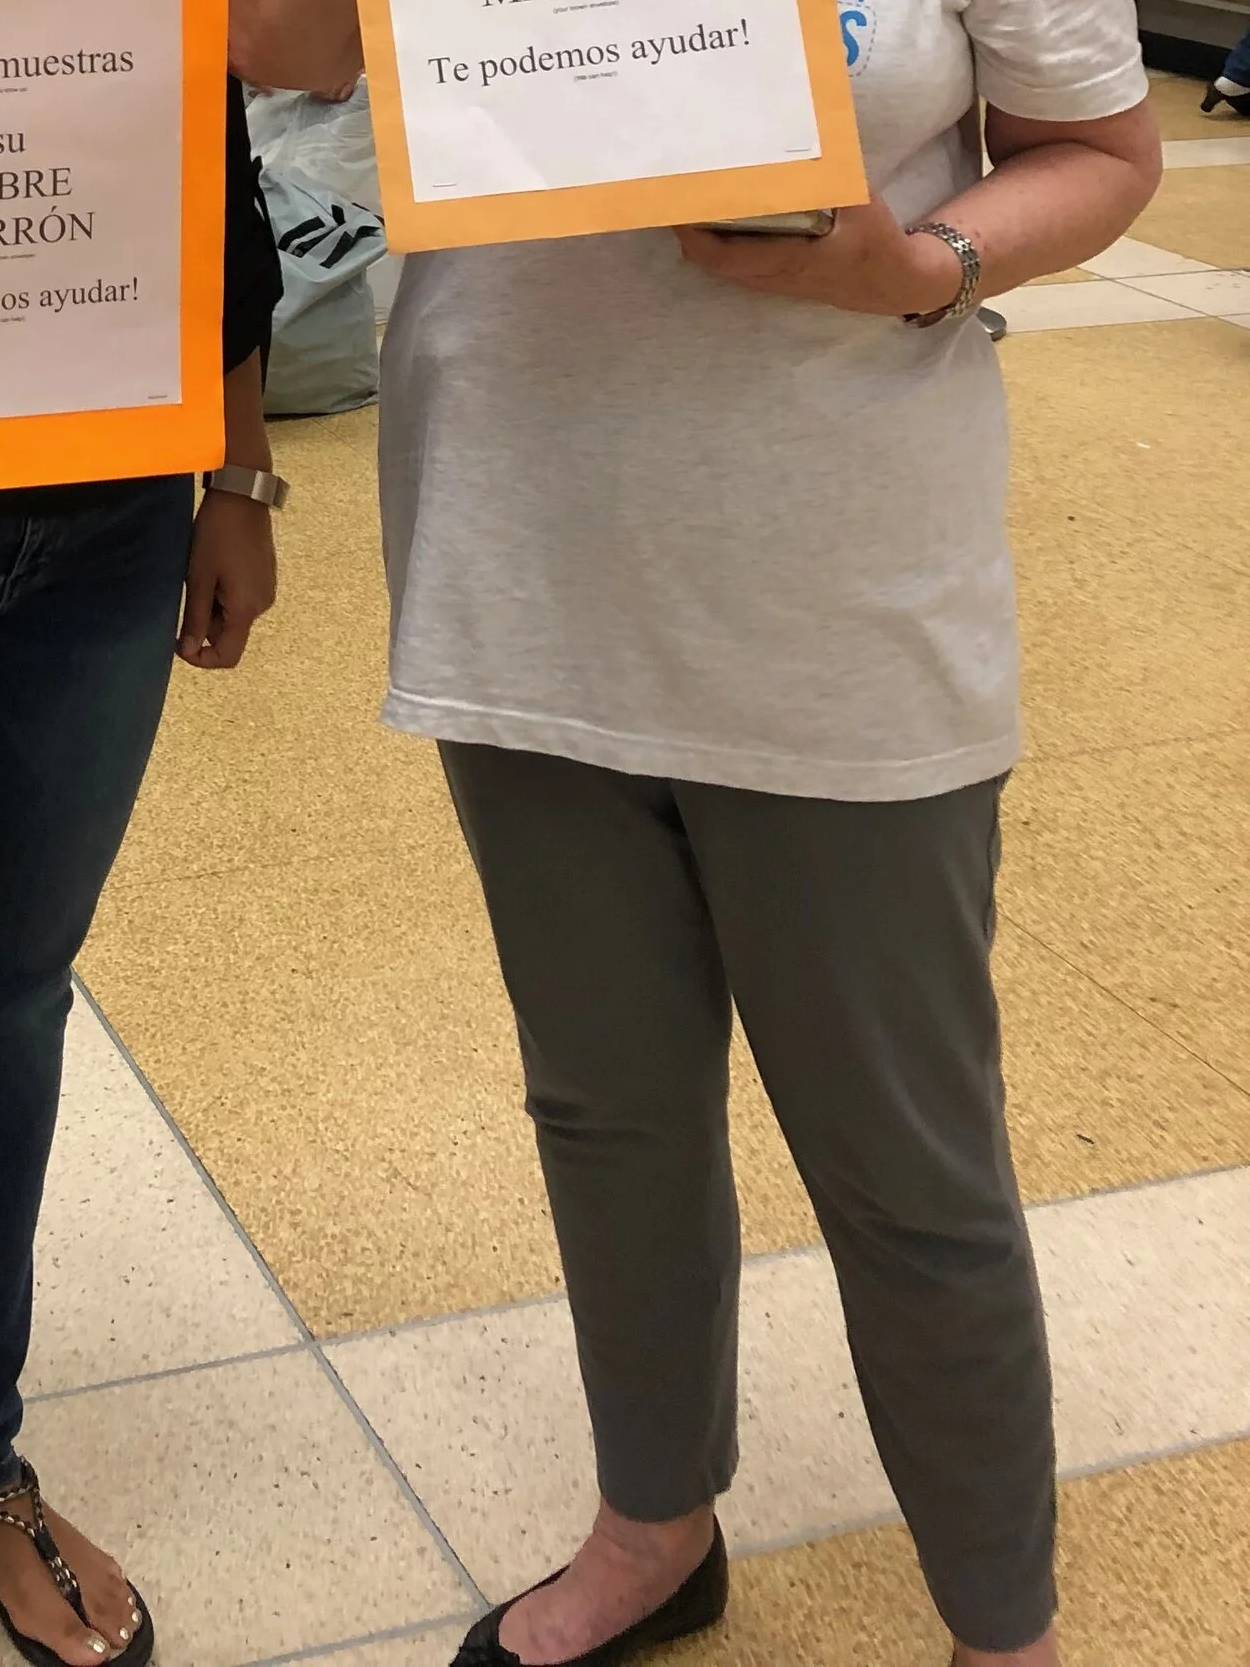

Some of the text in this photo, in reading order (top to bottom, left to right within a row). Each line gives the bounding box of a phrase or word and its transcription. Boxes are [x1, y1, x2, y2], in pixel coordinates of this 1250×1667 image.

[427, 18, 751, 87] Te podemos ayudar!
[39, 276, 139, 313] ayudar!
